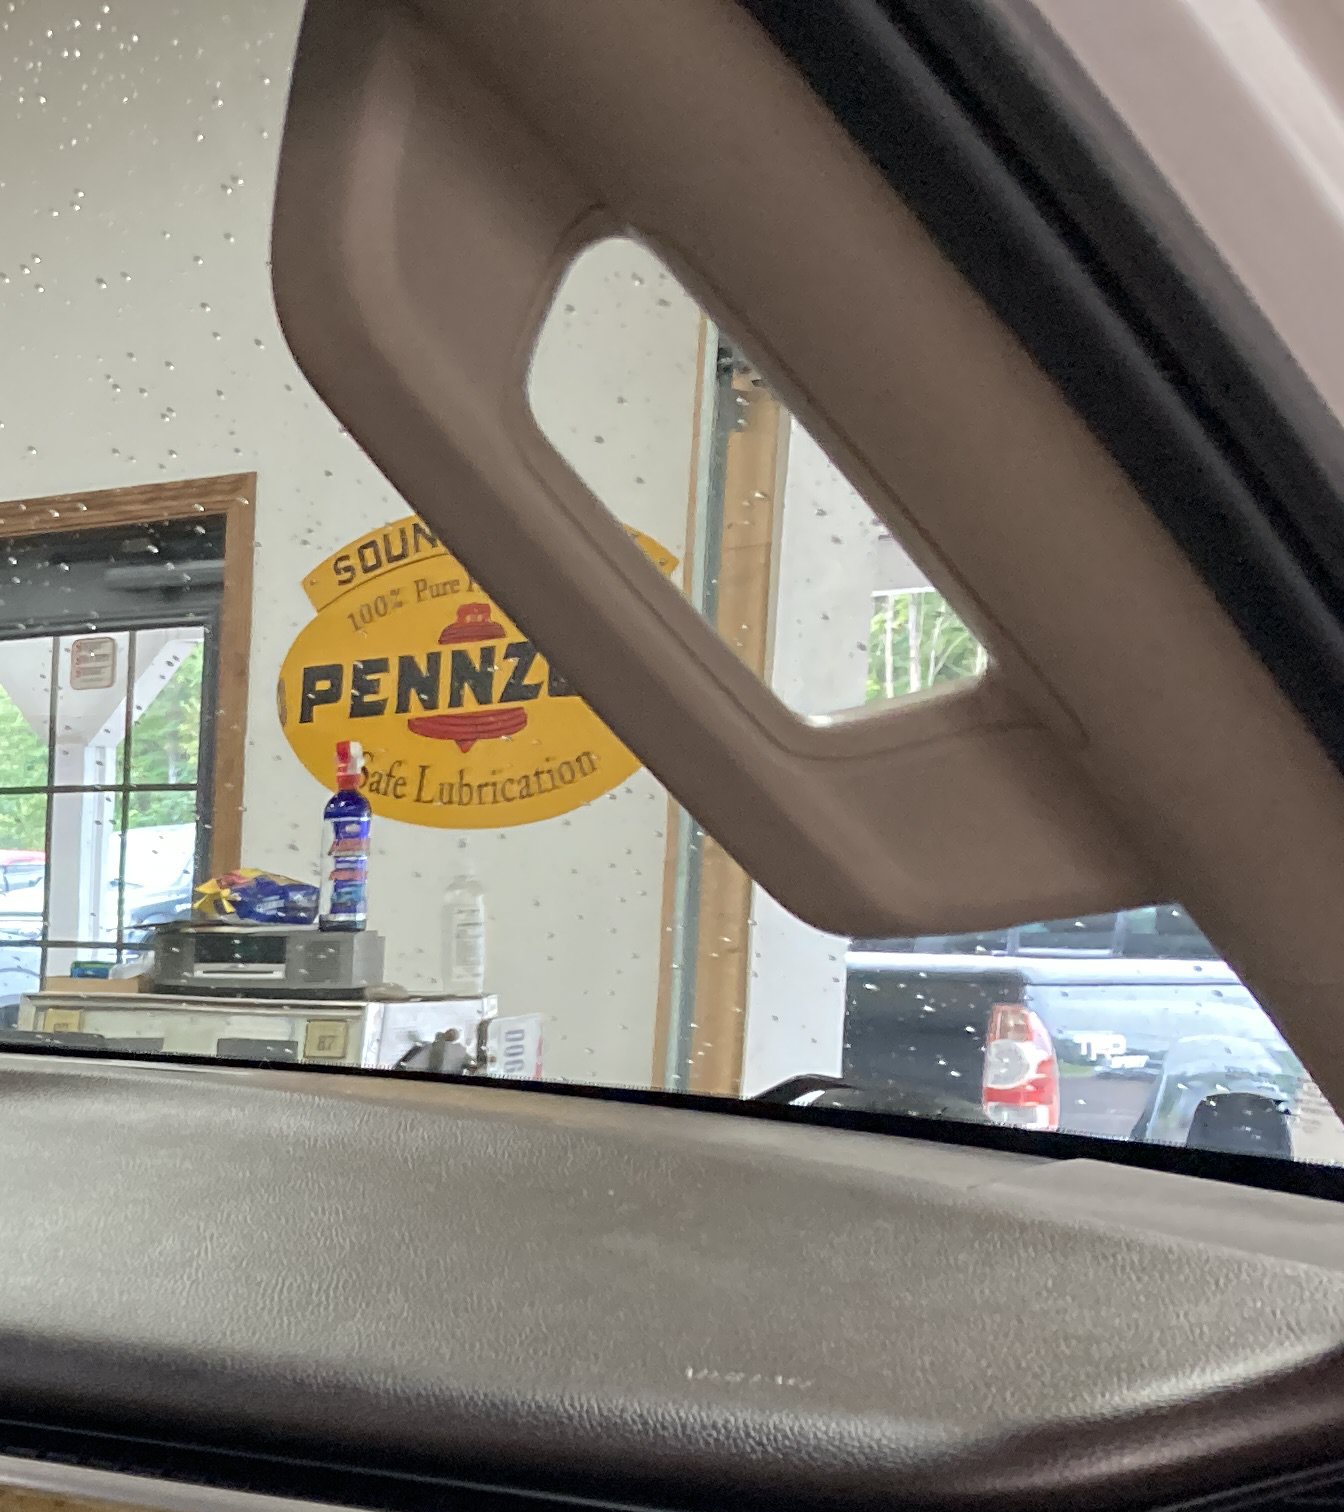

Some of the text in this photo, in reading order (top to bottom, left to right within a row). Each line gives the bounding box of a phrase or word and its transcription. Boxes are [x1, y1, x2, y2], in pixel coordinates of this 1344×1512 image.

[333, 523, 439, 585] SOUN
[347, 588, 405, 632] 100%
[413, 577, 461, 602] Pure
[299, 641, 574, 724] PENNZ
[414, 750, 598, 806] Lubrication
